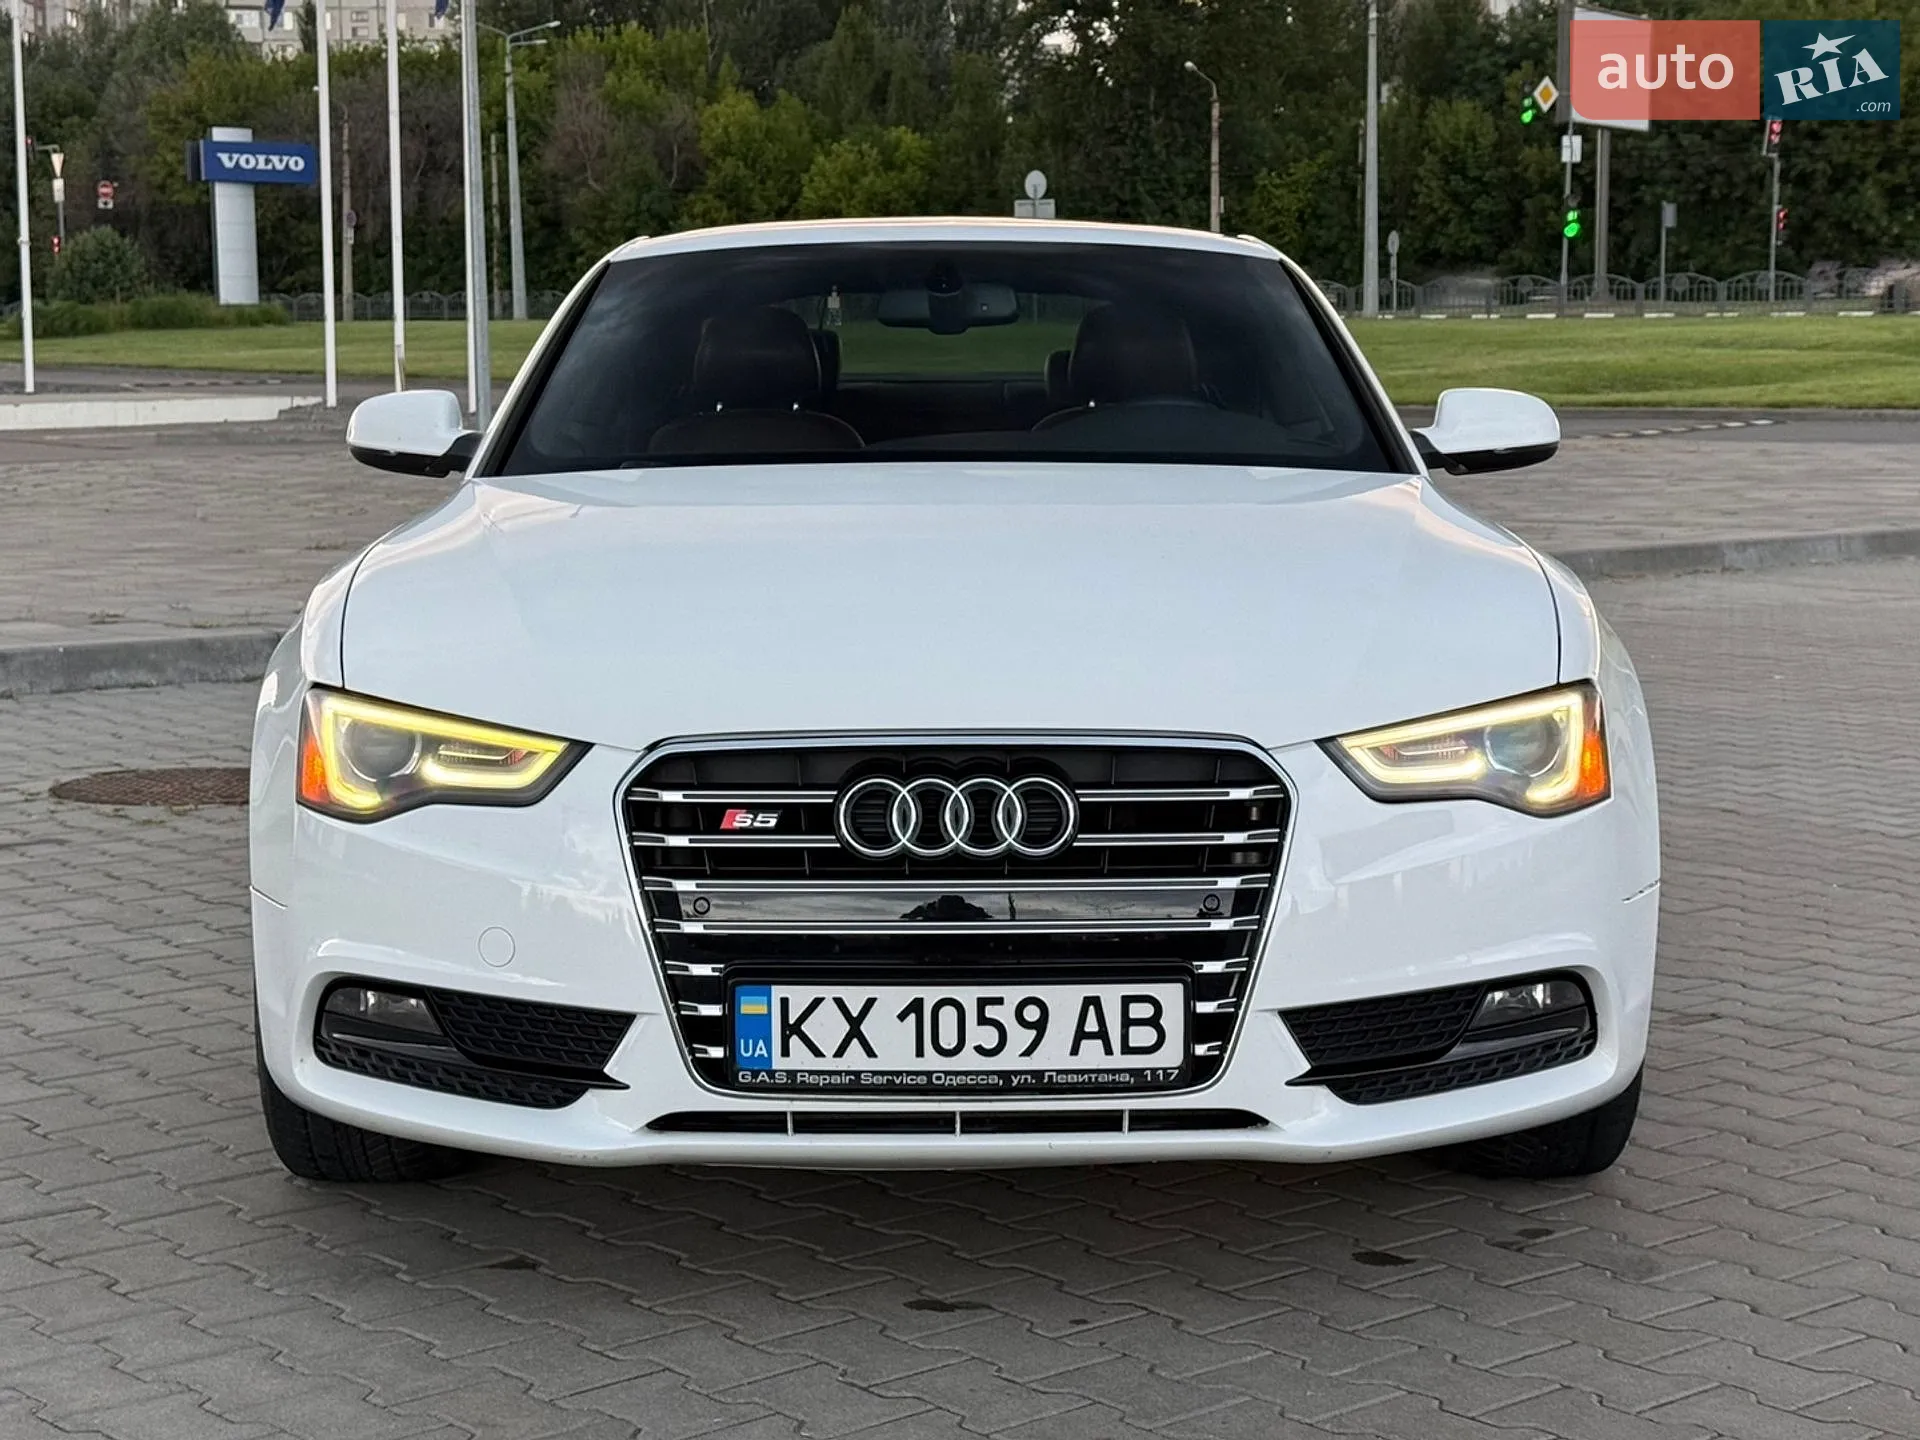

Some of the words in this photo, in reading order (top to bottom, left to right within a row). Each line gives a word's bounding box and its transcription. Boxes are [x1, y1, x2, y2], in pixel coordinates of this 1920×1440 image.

[216, 152, 305, 172] VOLVO
[732, 812, 779, 828] S5
[778, 996, 878, 1059] KX
[895, 996, 1050, 1059] 1059
[1069, 994, 1167, 1057] AB
[740, 1038, 768, 1058] UA
[738, 1070, 792, 1084] G.A.S.
[796, 1071, 855, 1087] Repair
[860, 1072, 927, 1085] Service
[931, 1072, 1004, 1087] Одесса,
[1010, 1074, 1037, 1087] ул.
[1043, 1071, 1135, 1085] Левитана,
[1143, 1069, 1180, 1082] 117
